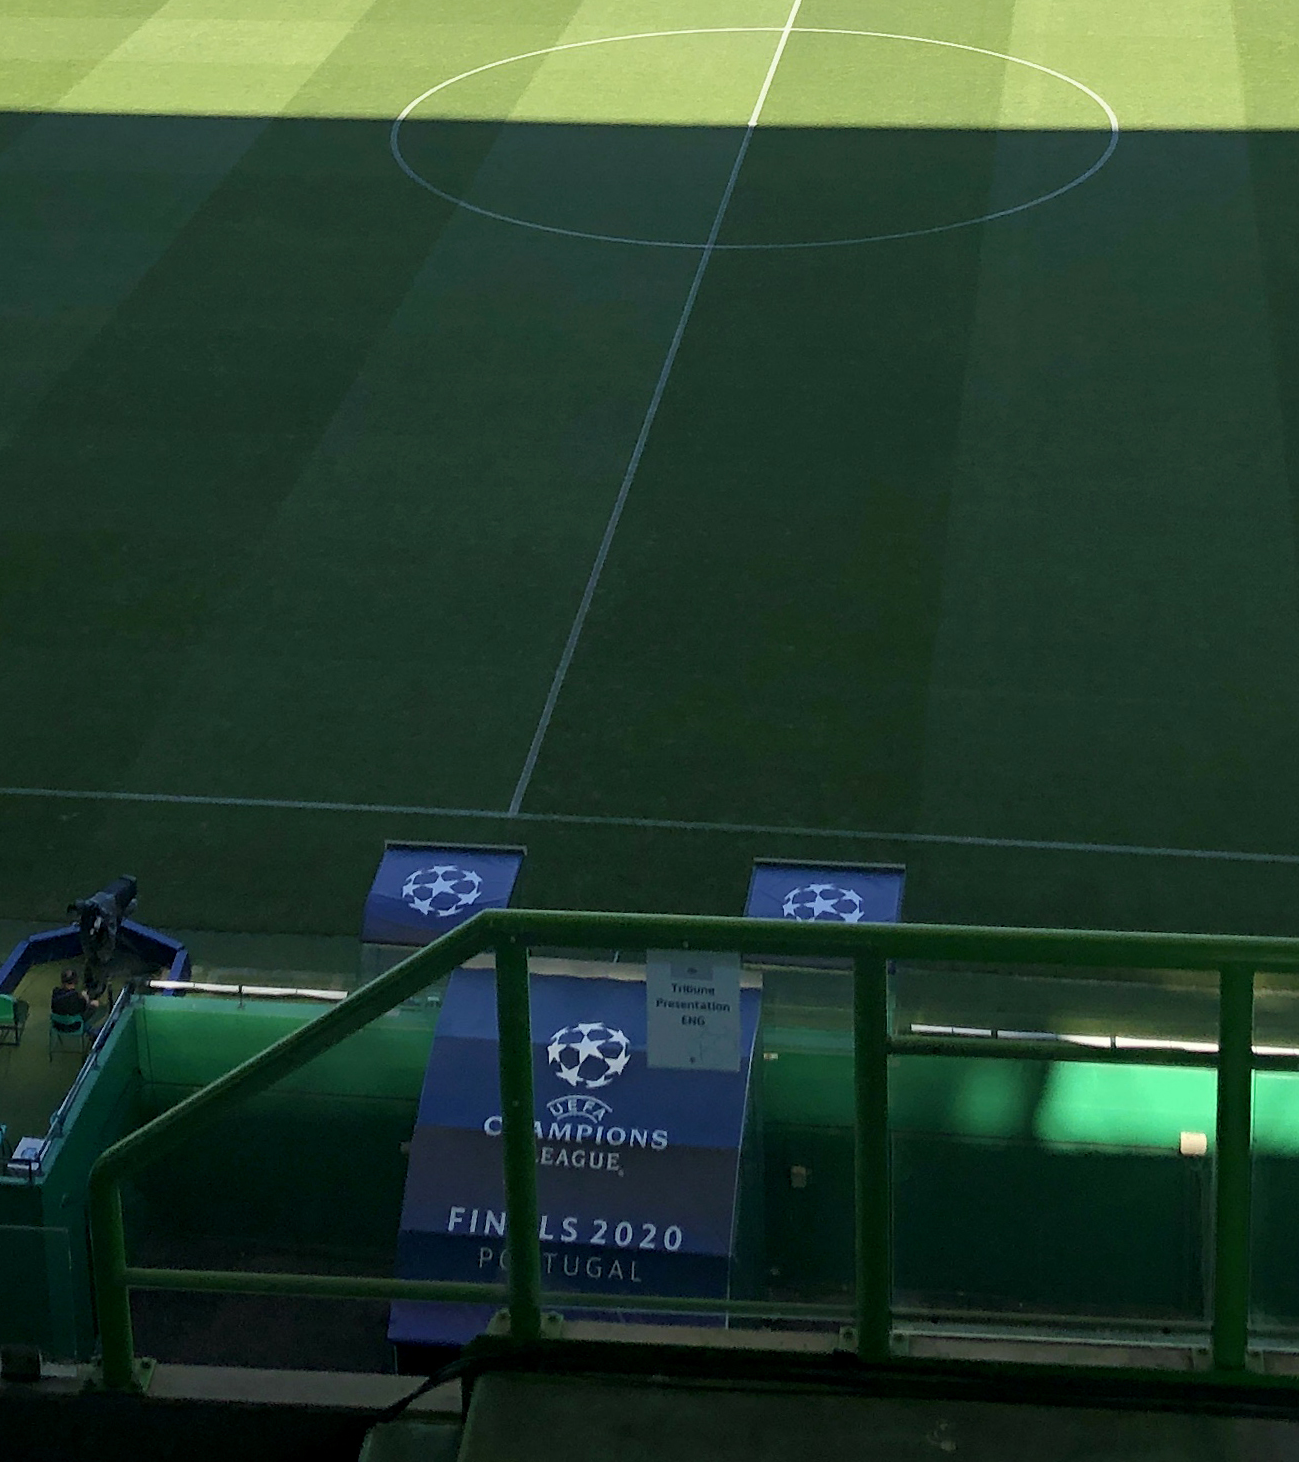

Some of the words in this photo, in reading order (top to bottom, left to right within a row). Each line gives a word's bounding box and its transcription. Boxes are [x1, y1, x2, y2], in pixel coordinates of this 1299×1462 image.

[656, 998, 731, 1012] Presentation
[681, 1015, 706, 1026] ENG
[549, 1098, 606, 1121] UEFA
[484, 1115, 668, 1150] CAMPIONS
[535, 1146, 620, 1171] EAGUE
[448, 1206, 578, 1242] FINLS
[590, 1219, 683, 1251] 2020
[479, 1246, 642, 1282] POTUGAL
